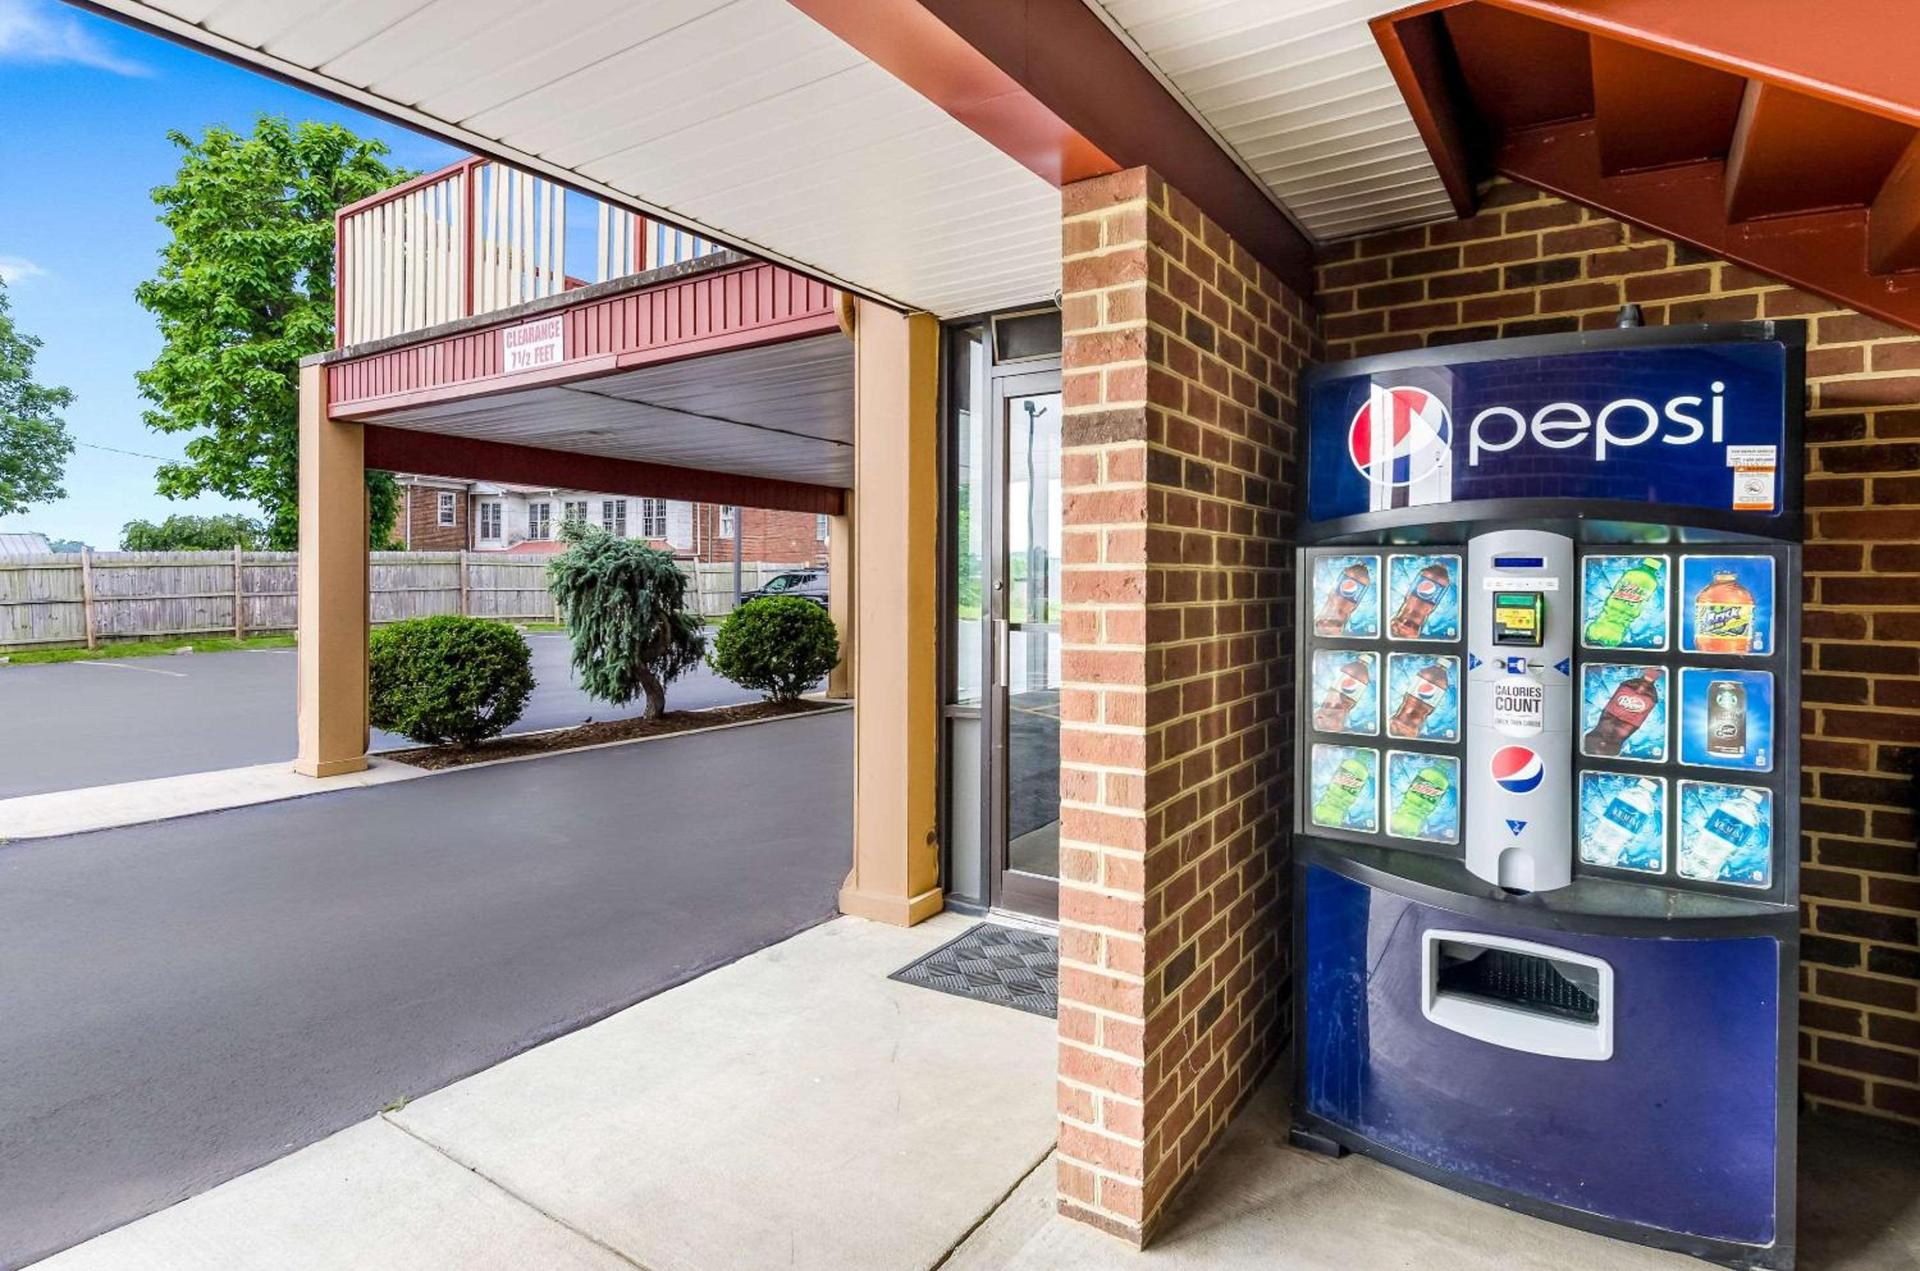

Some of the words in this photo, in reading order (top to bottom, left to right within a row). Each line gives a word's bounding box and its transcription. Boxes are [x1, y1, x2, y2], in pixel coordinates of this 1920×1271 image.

[506, 320, 561, 348] CLEARANCE
[534, 344, 556, 364] FEET
[1468, 380, 1725, 467] pepsi
[1495, 685, 1542, 698] CALORIES
[1495, 696, 1542, 713] COUNT
